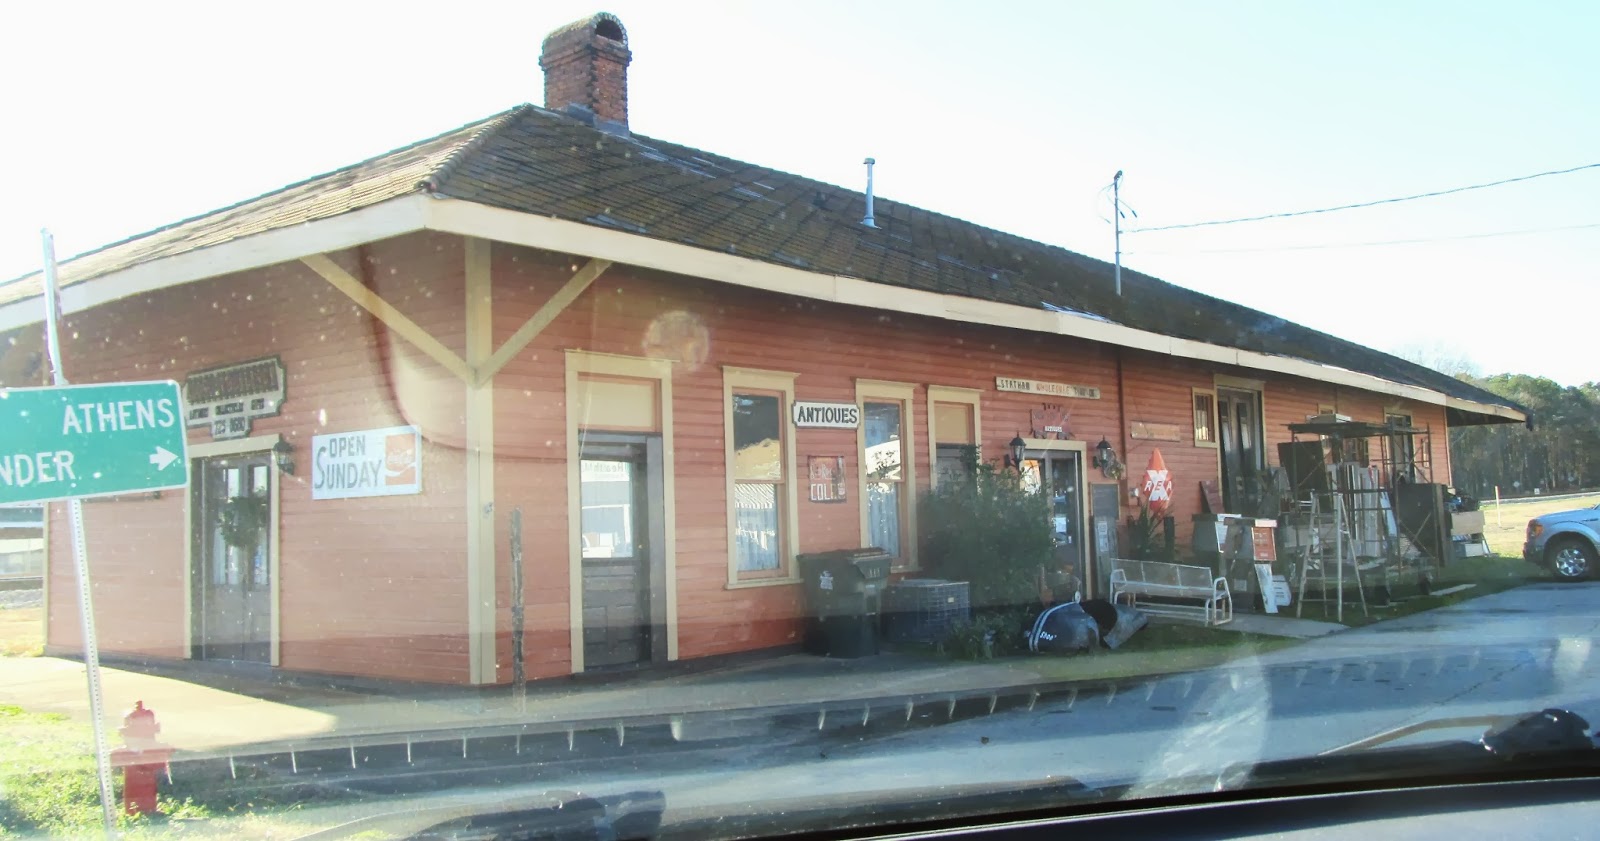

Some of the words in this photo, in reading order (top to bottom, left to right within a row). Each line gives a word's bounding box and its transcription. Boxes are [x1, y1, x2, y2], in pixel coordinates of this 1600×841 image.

[62, 398, 175, 435] ATHENS
[797, 406, 858, 424] ANTIQUES
[329, 434, 366, 458] OPEN
[314, 446, 382, 489] SUNDAY
[1144, 480, 1173, 493] REA
